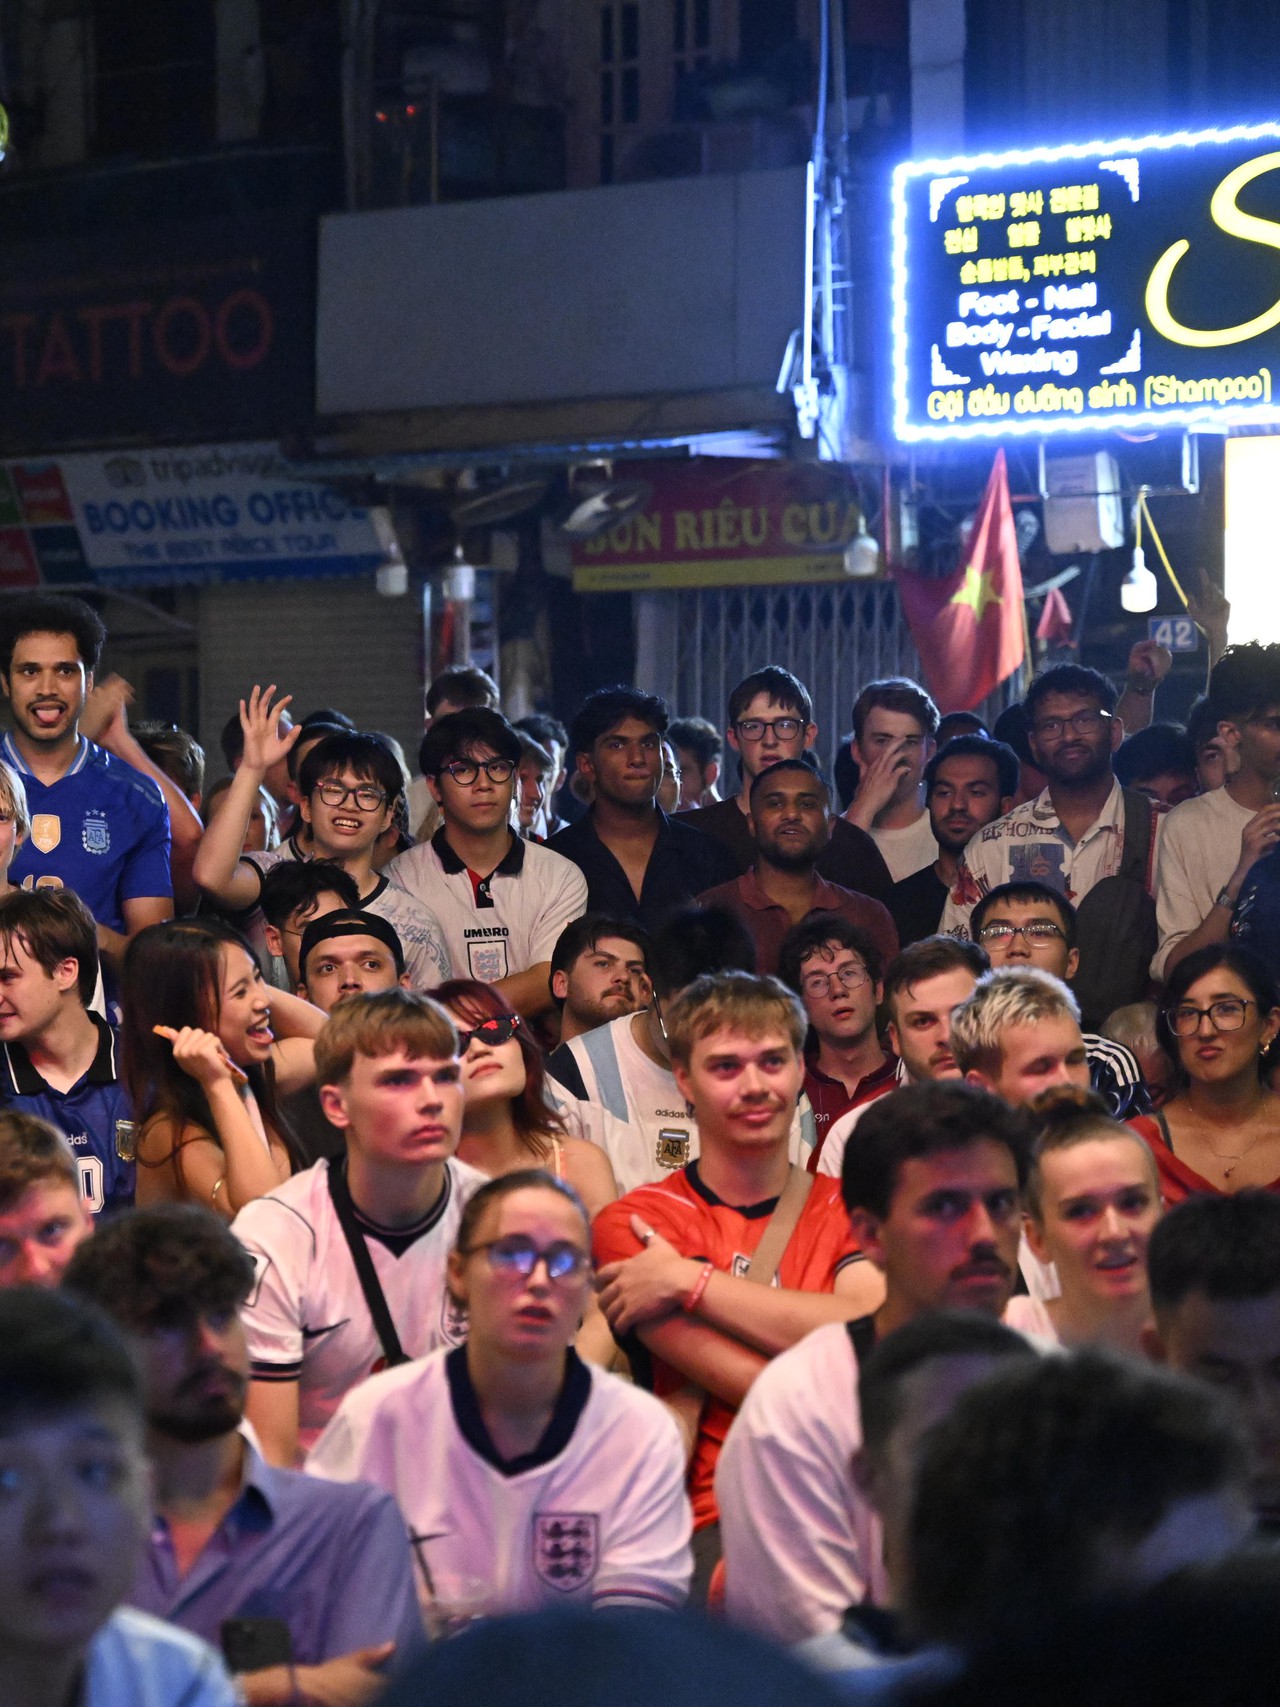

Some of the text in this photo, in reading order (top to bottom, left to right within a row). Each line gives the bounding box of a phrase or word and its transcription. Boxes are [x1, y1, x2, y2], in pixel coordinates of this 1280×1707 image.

[958, 289, 1020, 318] Foot
[1043, 281, 1097, 311] Nail
[1, 288, 273, 386] TATTOO
[946, 318, 1015, 349] Body
[1031, 309, 1112, 341] Facial
[979, 347, 1078, 377] Waxing
[1088, 378, 1137, 409] sinh
[83, 496, 239, 534] BOOKING
[674, 498, 768, 550] RIÊU
[1155, 620, 1193, 648] 42
[463, 927, 509, 938] UMBRO
[655, 1108, 686, 1119] adidas
